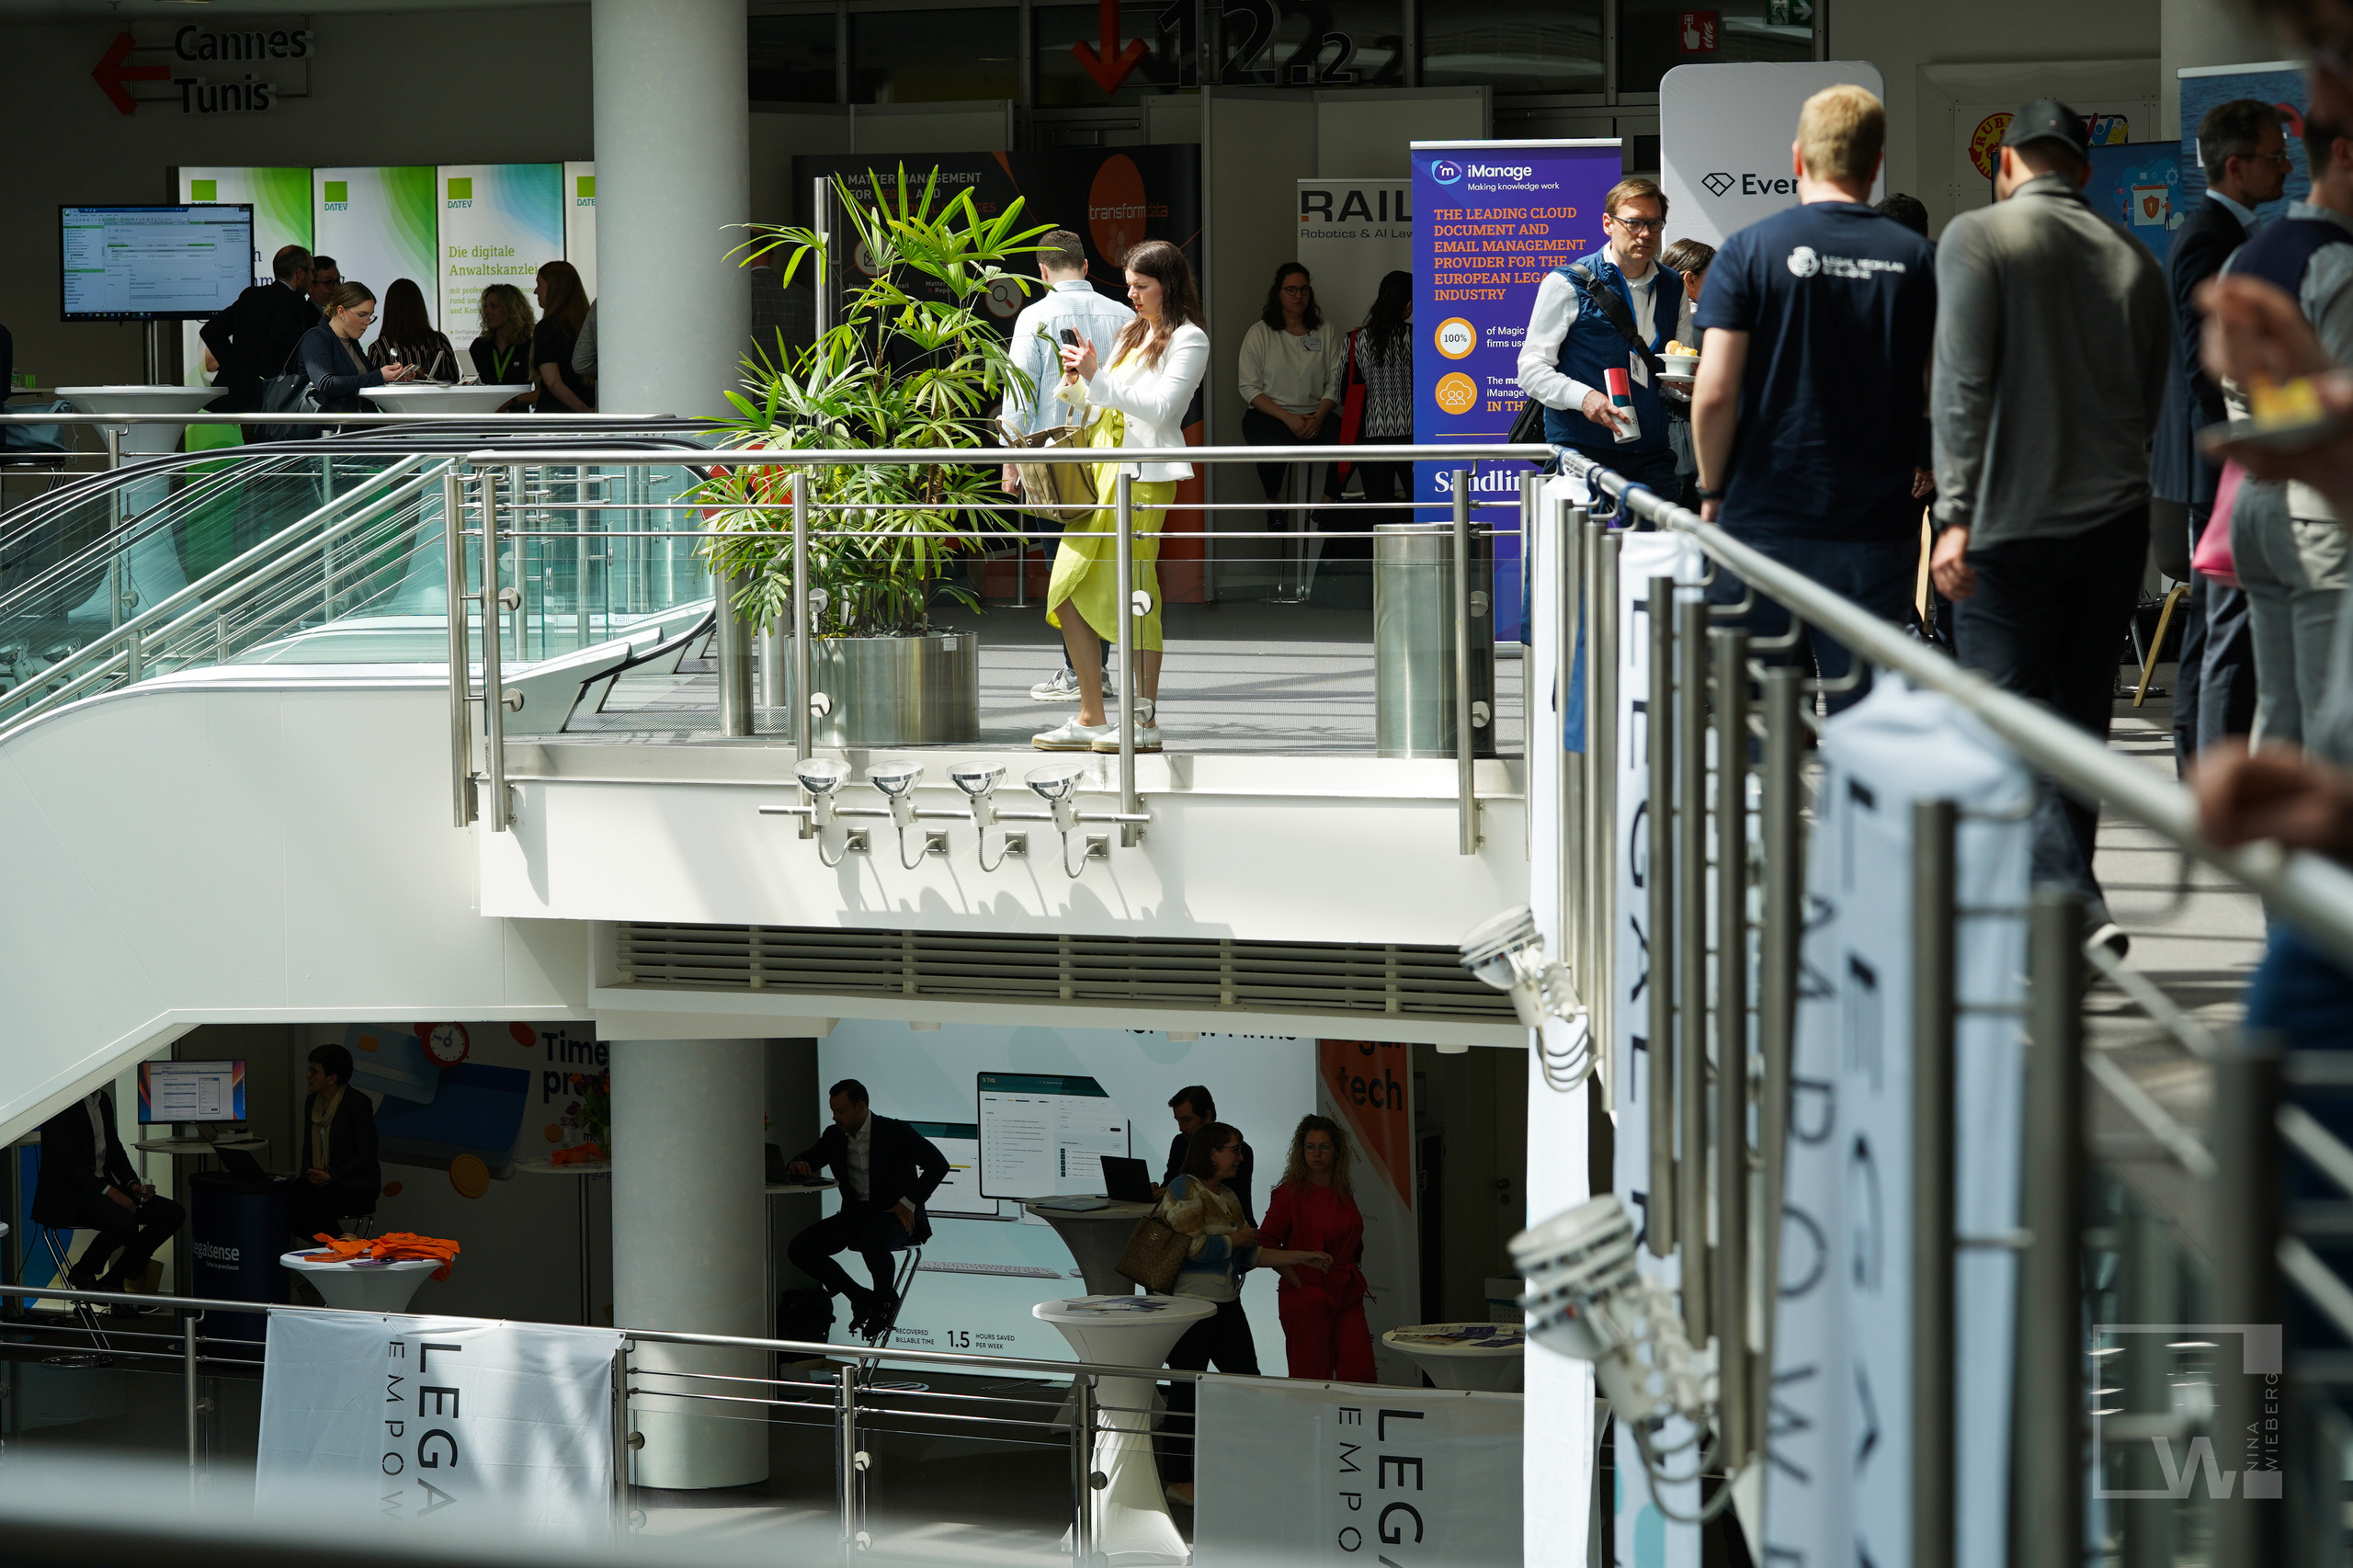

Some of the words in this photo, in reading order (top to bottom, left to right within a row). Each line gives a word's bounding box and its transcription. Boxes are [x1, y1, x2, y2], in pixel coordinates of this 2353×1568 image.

[175, 25, 307, 61] Cannes
[174, 74, 270, 113] Tunis
[1975, 117, 2012, 147] RUB
[1467, 165, 1532, 181] iManage
[915, 188, 941, 199] AD
[1468, 183, 1495, 192] Making
[1498, 183, 1540, 191] knowledge
[324, 203, 348, 211] DATEV
[448, 200, 472, 209] DATEV
[1301, 190, 1413, 222] RAIL
[1434, 209, 1462, 221] THE
[1466, 208, 1528, 220] LEADING
[1530, 207, 1577, 219] CLOUD
[1301, 229, 1356, 238] Robotics
[1360, 229, 1370, 238] &
[1434, 223, 1516, 236] DOCUMENT
[1518, 223, 1550, 235] AND
[449, 245, 468, 258] Die
[472, 244, 516, 260] digitale
[1434, 241, 1479, 253] EMAIL
[1482, 239, 1586, 252] MANAGEMENT
[1434, 256, 1505, 268] PROVIDER
[1508, 256, 1536, 267] FOR
[1539, 256, 1568, 267] THE
[449, 263, 539, 276] Anwaltskanzlei
[1435, 272, 1511, 285] EUROPEAN
[1435, 289, 1506, 301] INDUSTRY
[1444, 334, 1468, 343] 100%
[1486, 326, 1496, 335] of
[1498, 326, 1525, 337] Magic
[1486, 339, 1509, 347] firms
[1486, 376, 1504, 385] The
[1486, 388, 1525, 399] iManage
[1486, 401, 1502, 412] IN
[1505, 401, 1527, 412] TH
[541, 1029, 608, 1066] Time
[1336, 1066, 1403, 1111] tech
[895, 1327, 929, 1336] RECOVERED
[975, 1333, 995, 1341] HOURS
[895, 1336, 921, 1345] BILLABLE
[948, 1330, 970, 1348] 1.5
[1378, 1408, 1425, 1568] LEG
